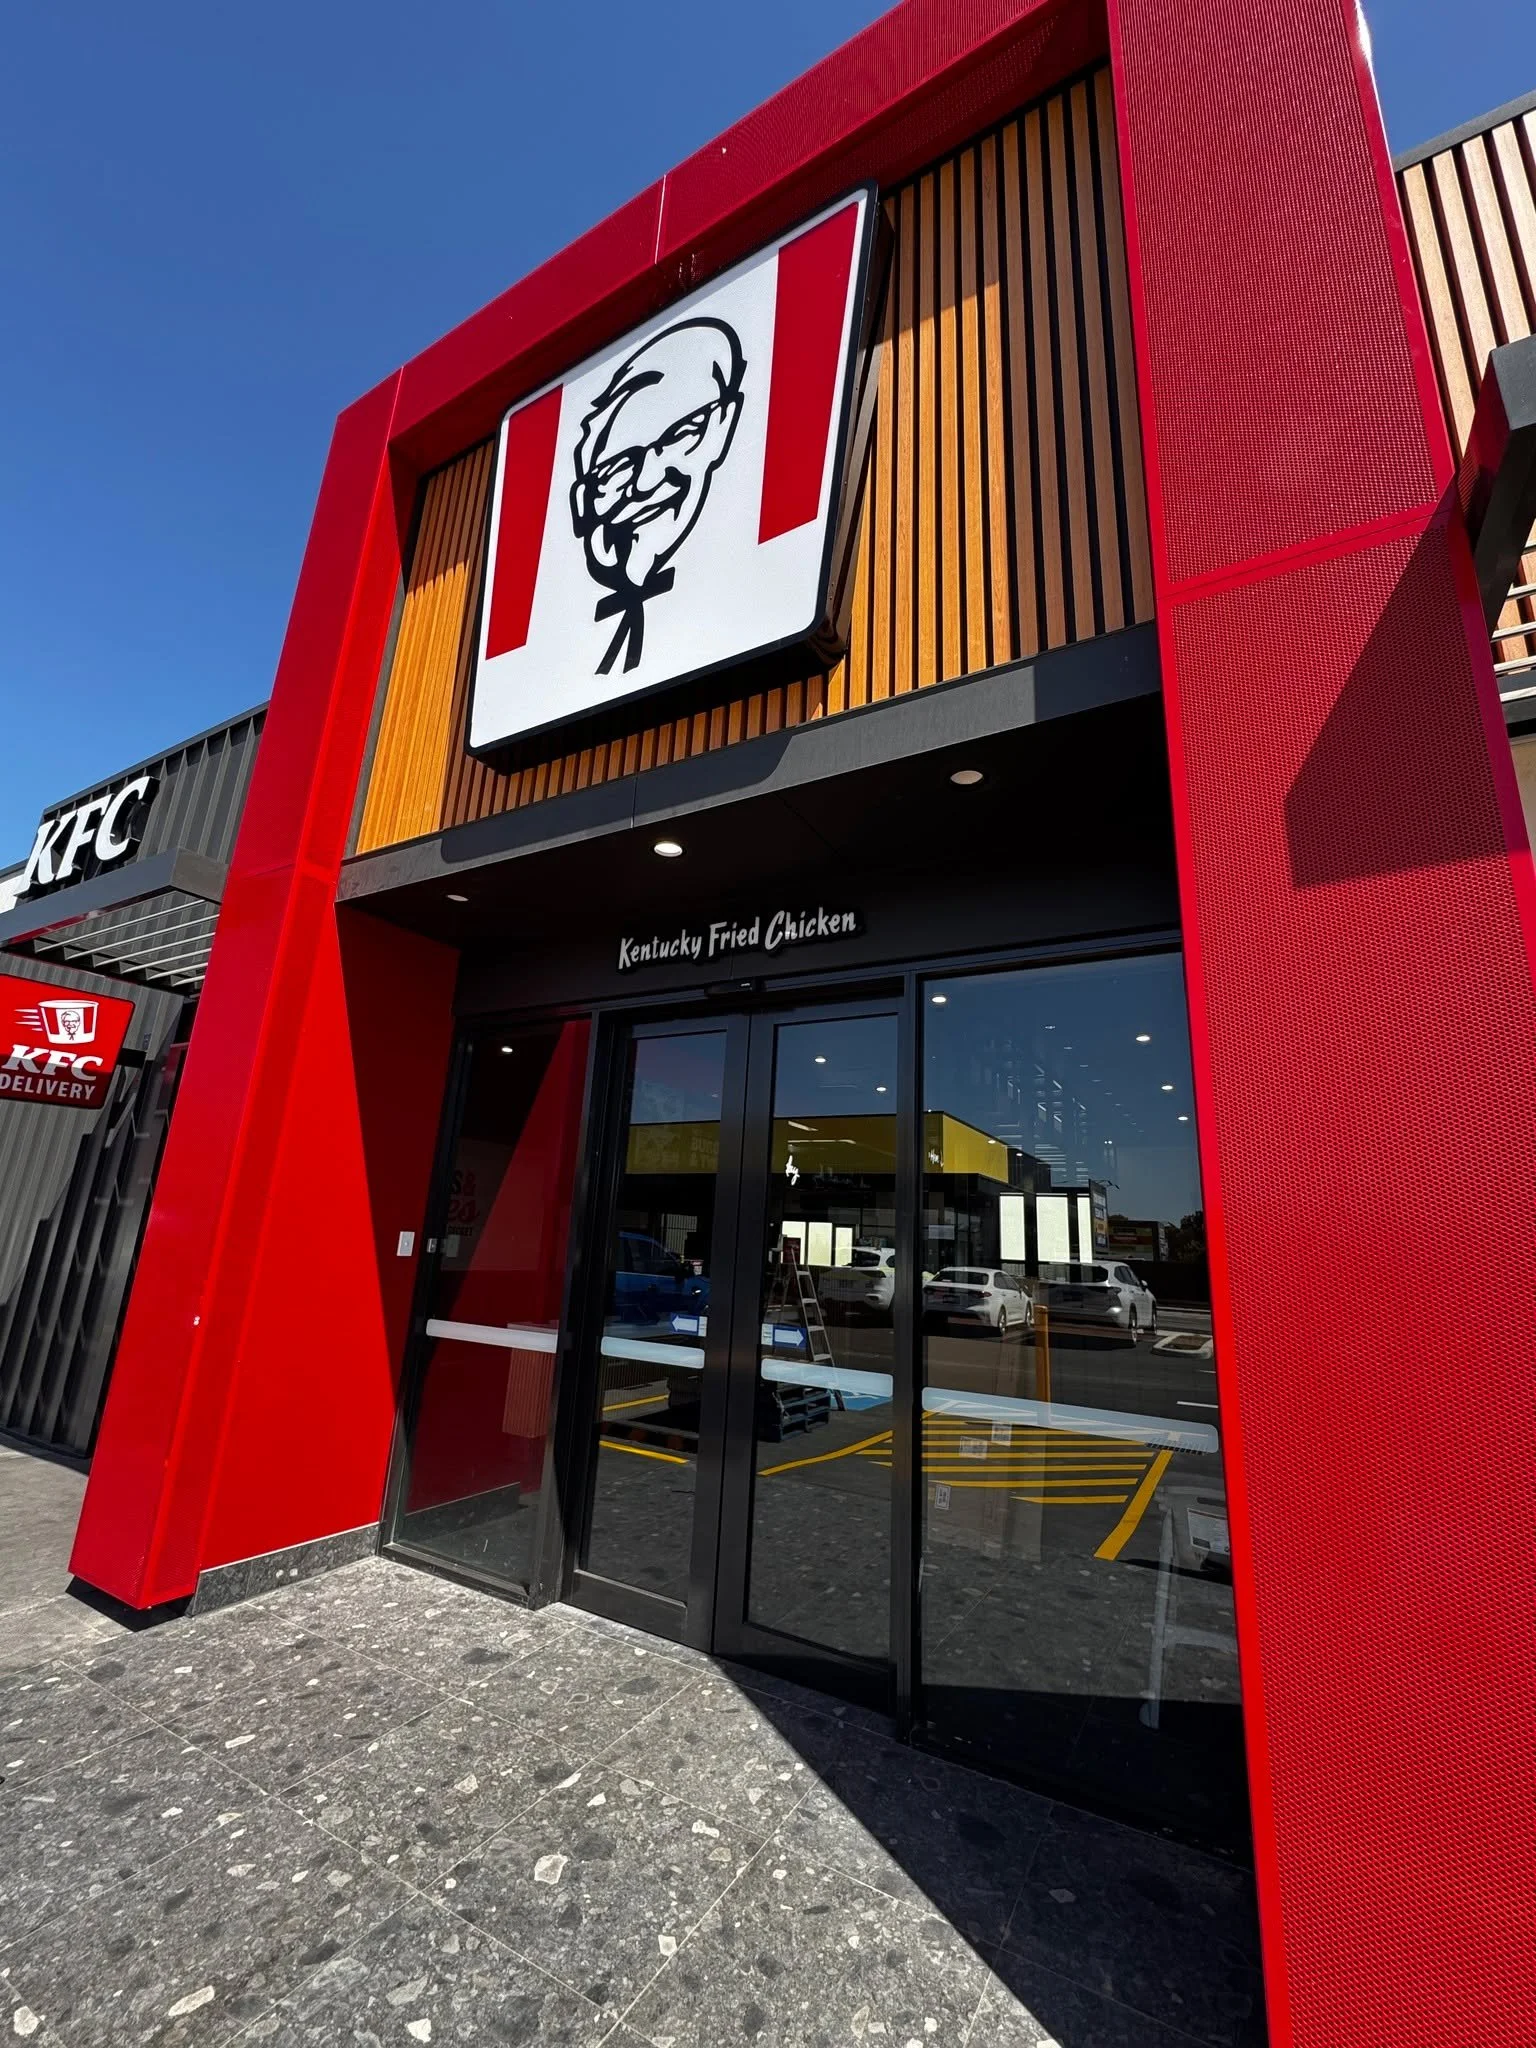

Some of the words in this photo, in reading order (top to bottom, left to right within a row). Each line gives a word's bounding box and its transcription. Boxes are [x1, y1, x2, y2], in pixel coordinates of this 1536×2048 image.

[15, 776, 150, 895] KFC
[618, 929, 702, 969] Kentucky
[709, 916, 759, 957] Fried
[764, 907, 856, 950] Chicken
[0, 1073, 96, 1101] DELIVERY
[2, 1044, 103, 1081] KFC
